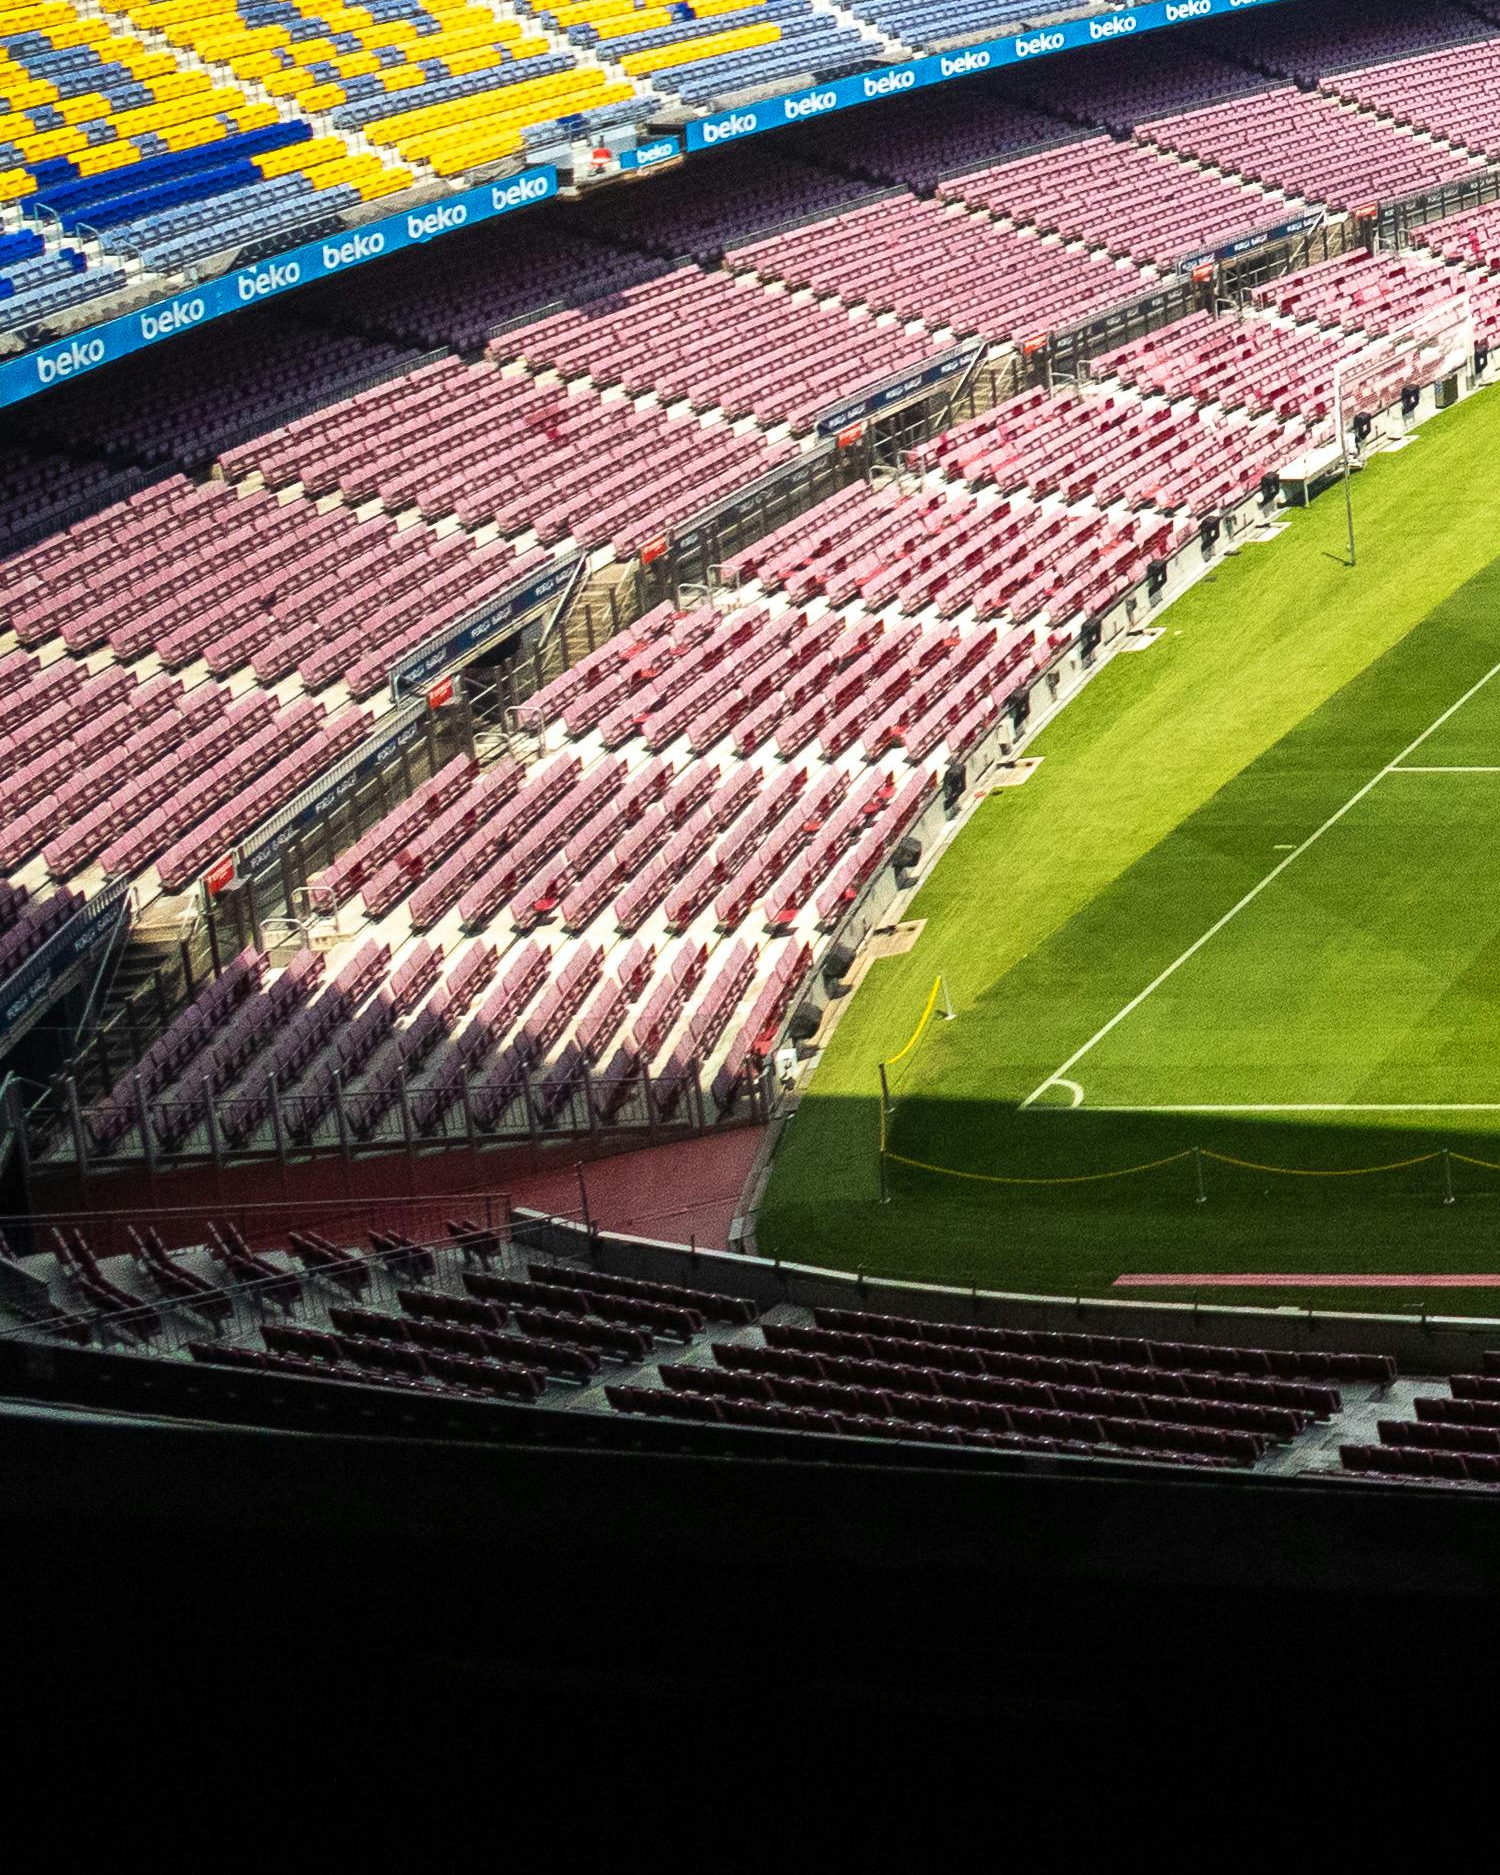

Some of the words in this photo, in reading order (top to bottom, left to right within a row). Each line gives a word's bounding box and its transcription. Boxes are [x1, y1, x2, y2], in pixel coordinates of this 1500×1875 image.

[1166, 0, 1210, 20] beko
[1090, 17, 1136, 38] beko
[1016, 33, 1064, 56] beko
[941, 52, 990, 76] beko
[864, 71, 914, 96] beko
[785, 92, 836, 118] beko
[704, 114, 756, 142] beko
[492, 175, 547, 209] beko
[408, 205, 466, 238] beko
[323, 234, 383, 268] beko
[239, 265, 299, 299] beko
[142, 300, 203, 339] beko
[38, 340, 104, 382] beko
